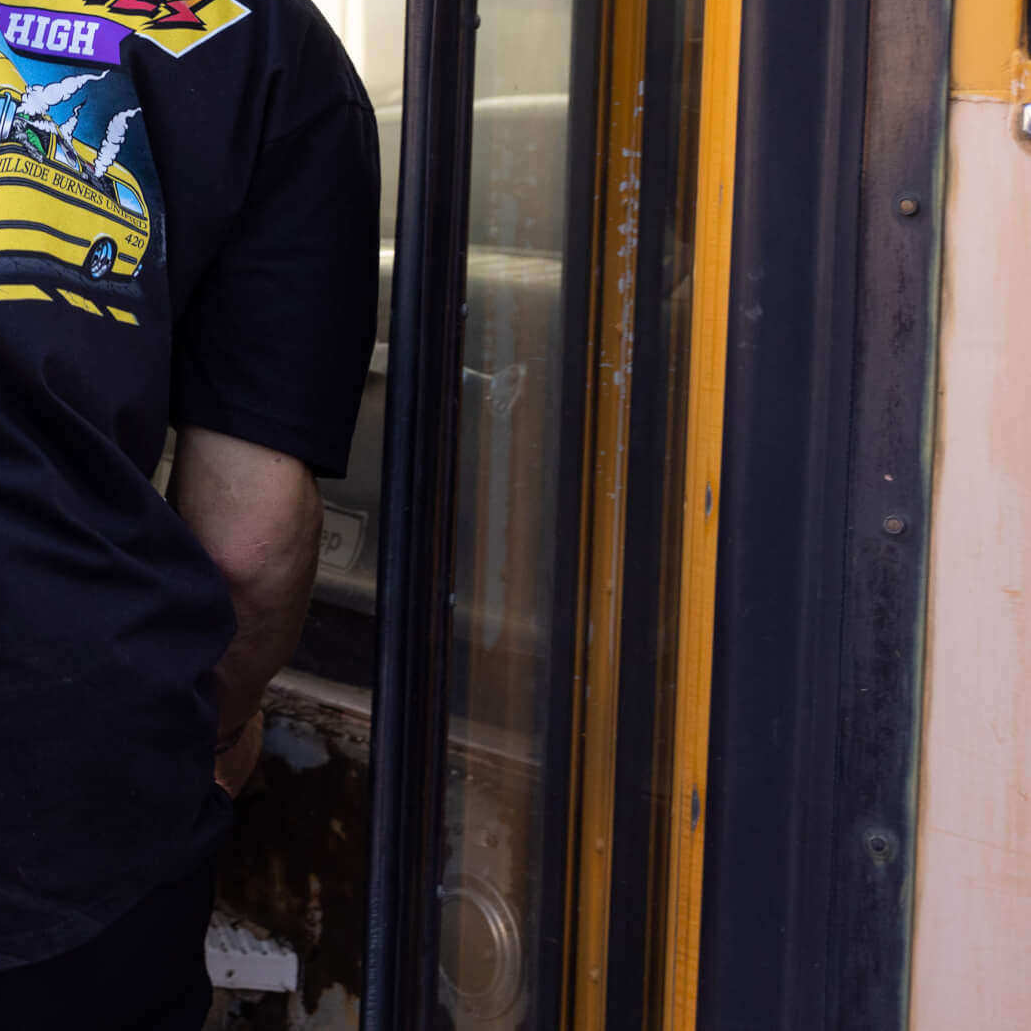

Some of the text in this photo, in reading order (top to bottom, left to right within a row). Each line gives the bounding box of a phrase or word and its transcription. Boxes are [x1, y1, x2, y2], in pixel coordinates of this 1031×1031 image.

[3, 12, 101, 57] HIGH
[52, 172, 104, 205] BURNERS
[124, 233, 145, 250] 420
